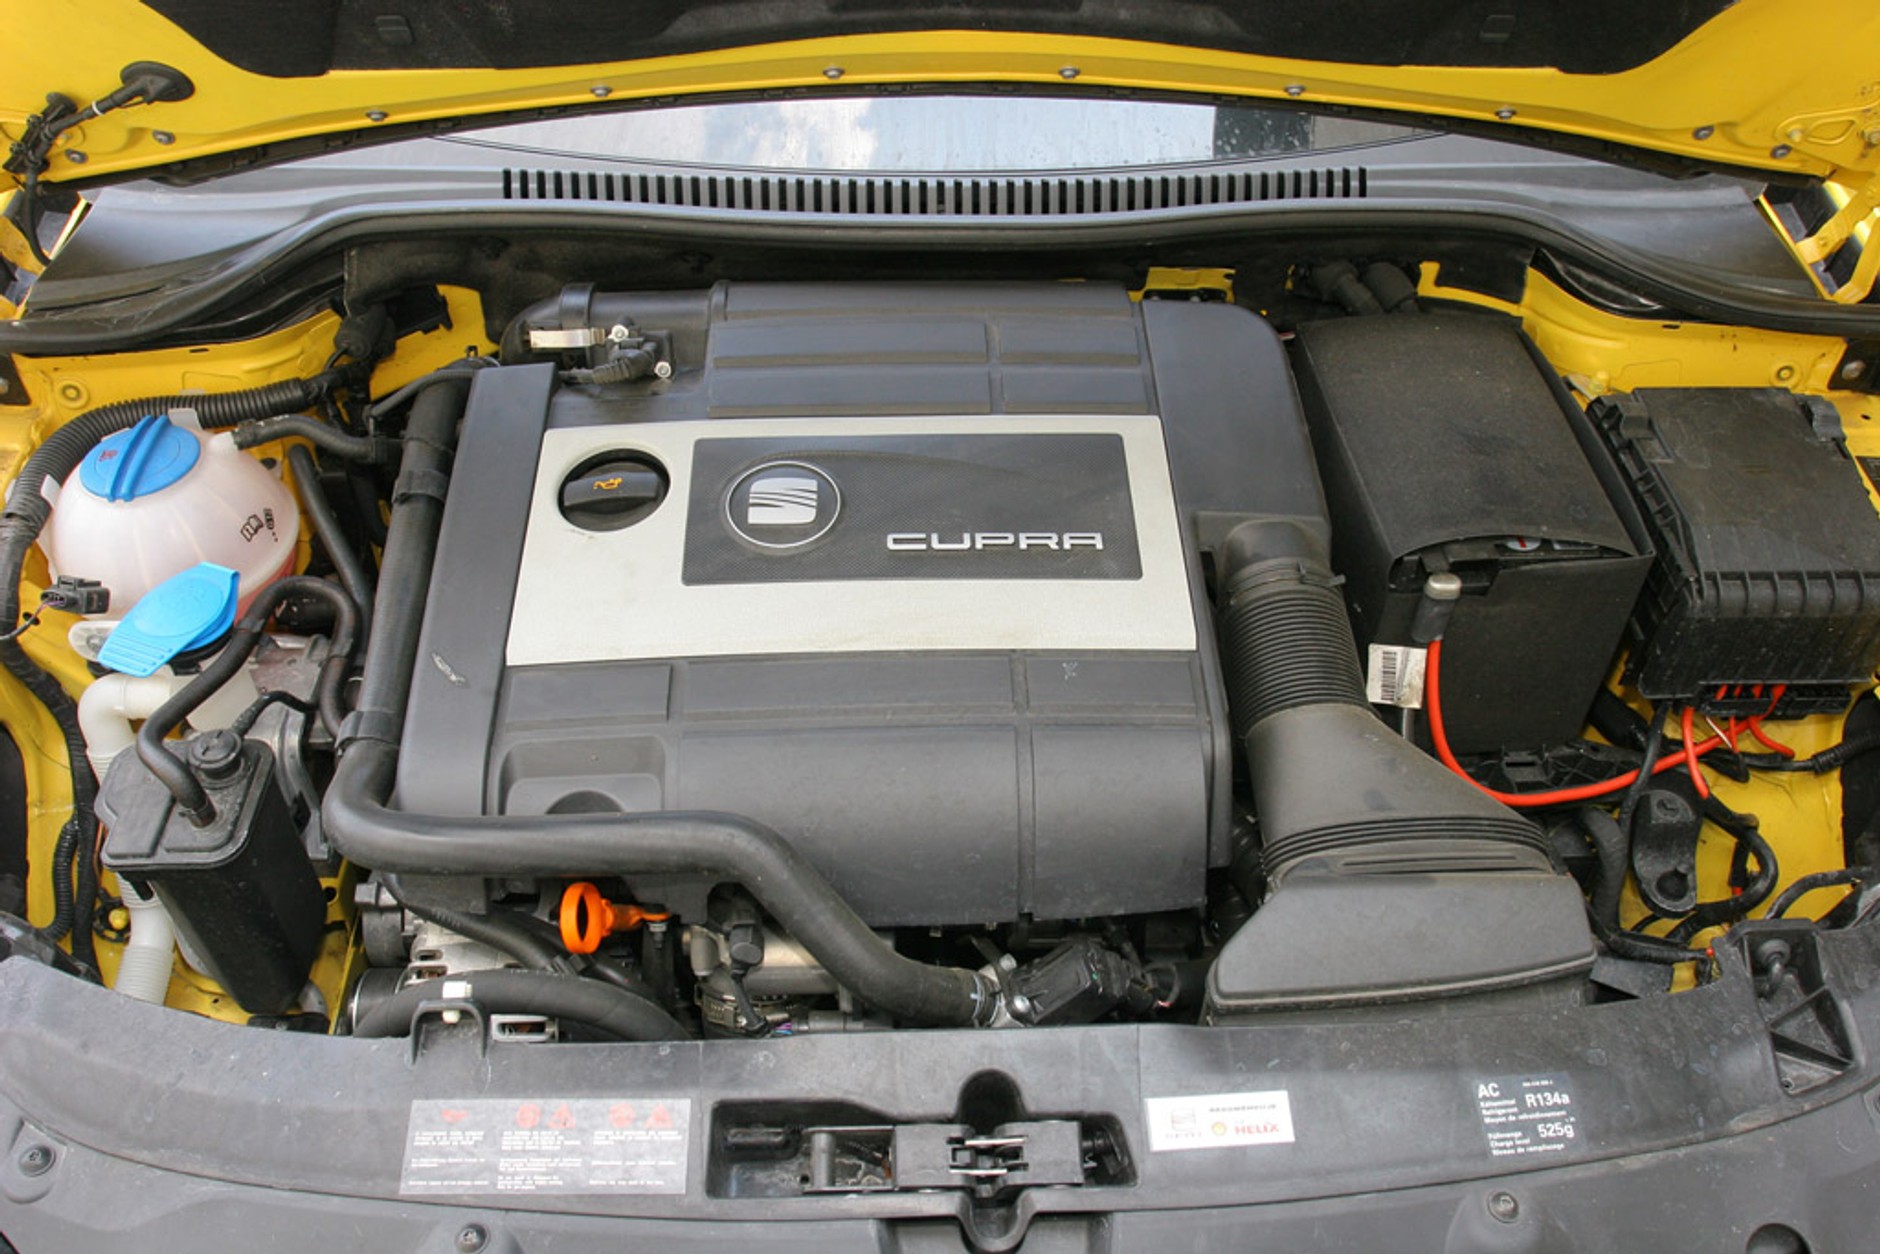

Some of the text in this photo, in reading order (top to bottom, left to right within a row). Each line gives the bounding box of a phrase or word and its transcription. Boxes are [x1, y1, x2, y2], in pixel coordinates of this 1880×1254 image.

[886, 532, 1104, 550] CUPRA
[1478, 1083, 1500, 1099] AC
[1524, 1091, 1571, 1108] R134a
[1233, 1123, 1280, 1135] HELIX
[1537, 1122, 1575, 1138] 525g
